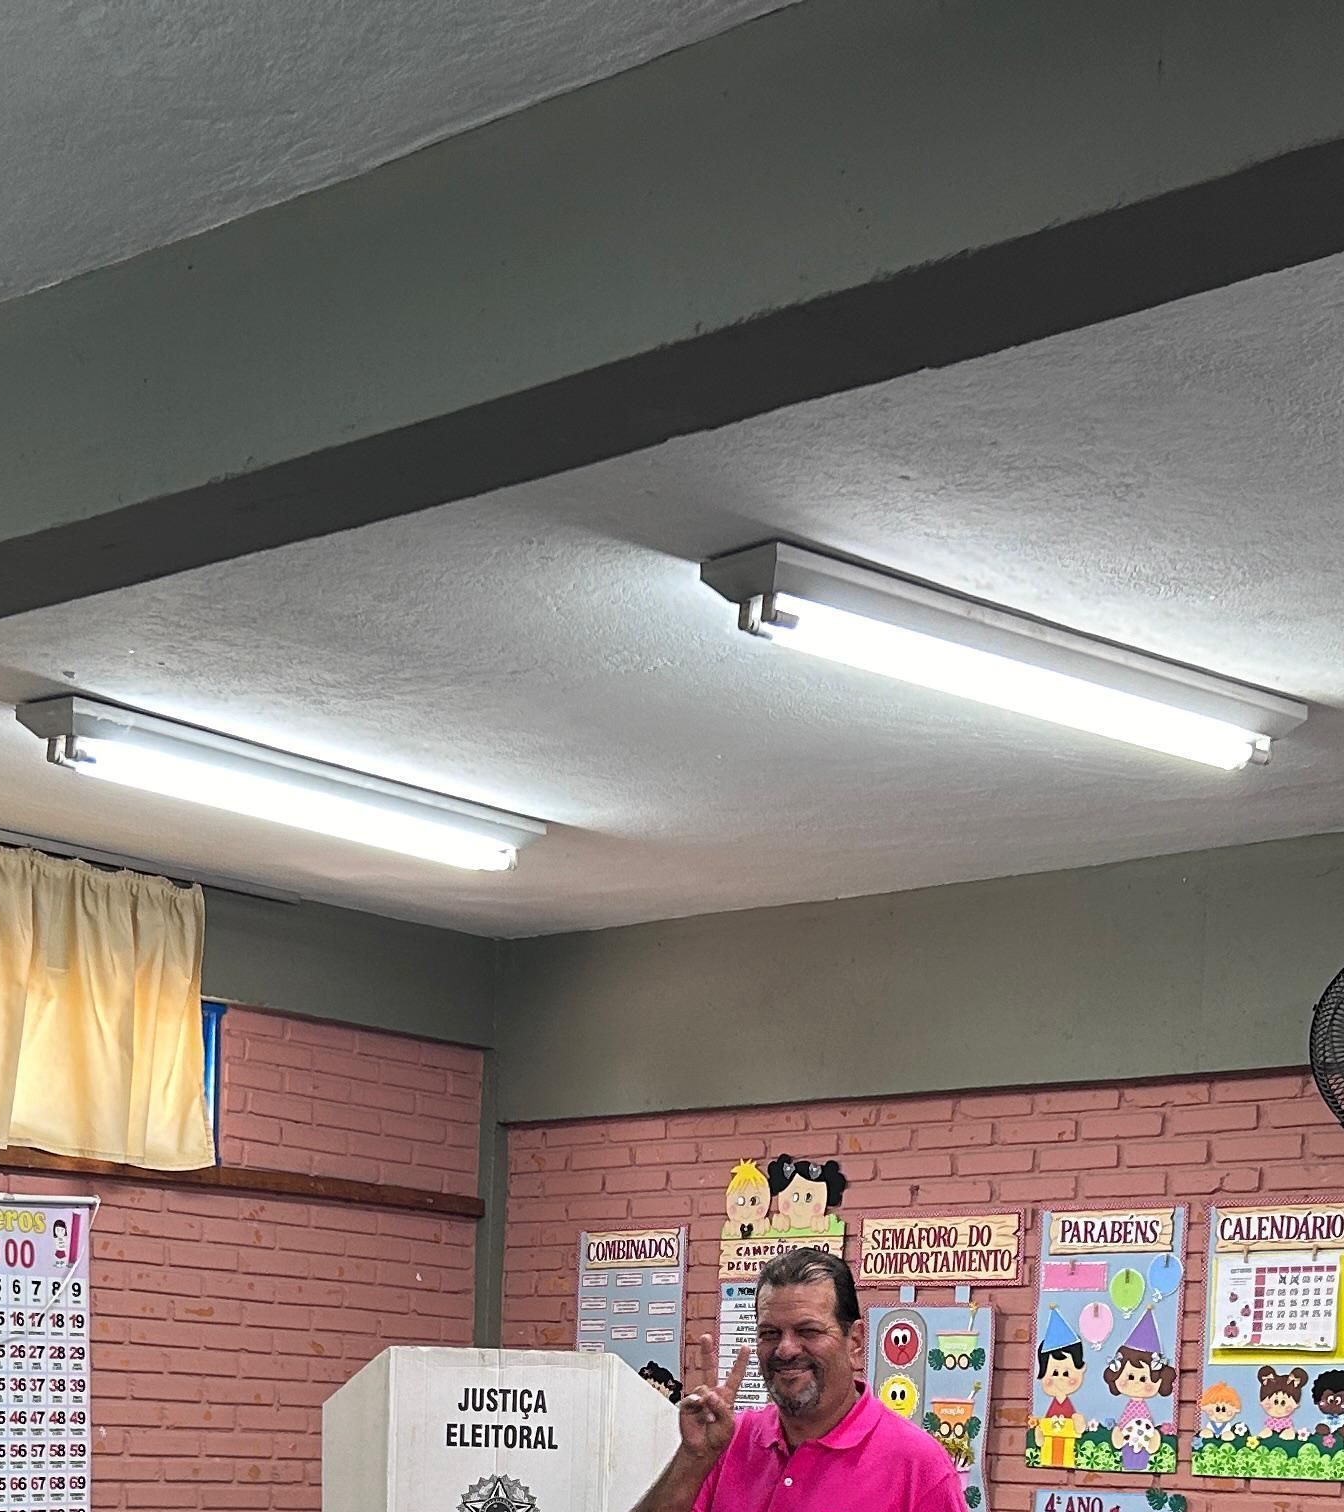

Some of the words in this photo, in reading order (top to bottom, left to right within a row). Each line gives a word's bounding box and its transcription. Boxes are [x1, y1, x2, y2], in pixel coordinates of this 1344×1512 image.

[871, 1222, 958, 1251] SEMÁFORO
[969, 1224, 992, 1247] DO
[1059, 1214, 1160, 1246] PARABÉNS
[1220, 1211, 1344, 1241] CALENDÁRIO
[587, 1238, 675, 1262] COMBINADOS
[863, 1249, 1013, 1276] COMPORTAMENTO
[12, 1279, 21, 1295] 6
[31, 1280, 42, 1295] 7
[72, 1282, 81, 1297] 9
[10, 1311, 25, 1326] 16
[49, 1313, 64, 1328] 18
[69, 1314, 85, 1329] 19
[10, 1345, 25, 1358] 26
[29, 1345, 45, 1359] 27
[49, 1346, 65, 1359] 28
[70, 1346, 85, 1360] 29
[10, 1378, 26, 1392] 36
[29, 1378, 45, 1392] 37
[49, 1378, 65, 1392] 38
[70, 1378, 86, 1392] 39
[457, 1387, 547, 1420] JUSTIÇA
[10, 1411, 27, 1424] 46
[30, 1411, 45, 1424] 47
[49, 1411, 65, 1424] 48
[70, 1411, 86, 1424] 49
[446, 1424, 558, 1450] ELEITORAL
[10, 1444, 27, 1458] 56
[31, 1444, 45, 1457] 57
[49, 1444, 65, 1457] 58
[70, 1444, 86, 1457] 59
[10, 1477, 27, 1490] 66
[31, 1477, 46, 1490] 67
[49, 1477, 65, 1490] 68
[69, 1476, 86, 1489] 69
